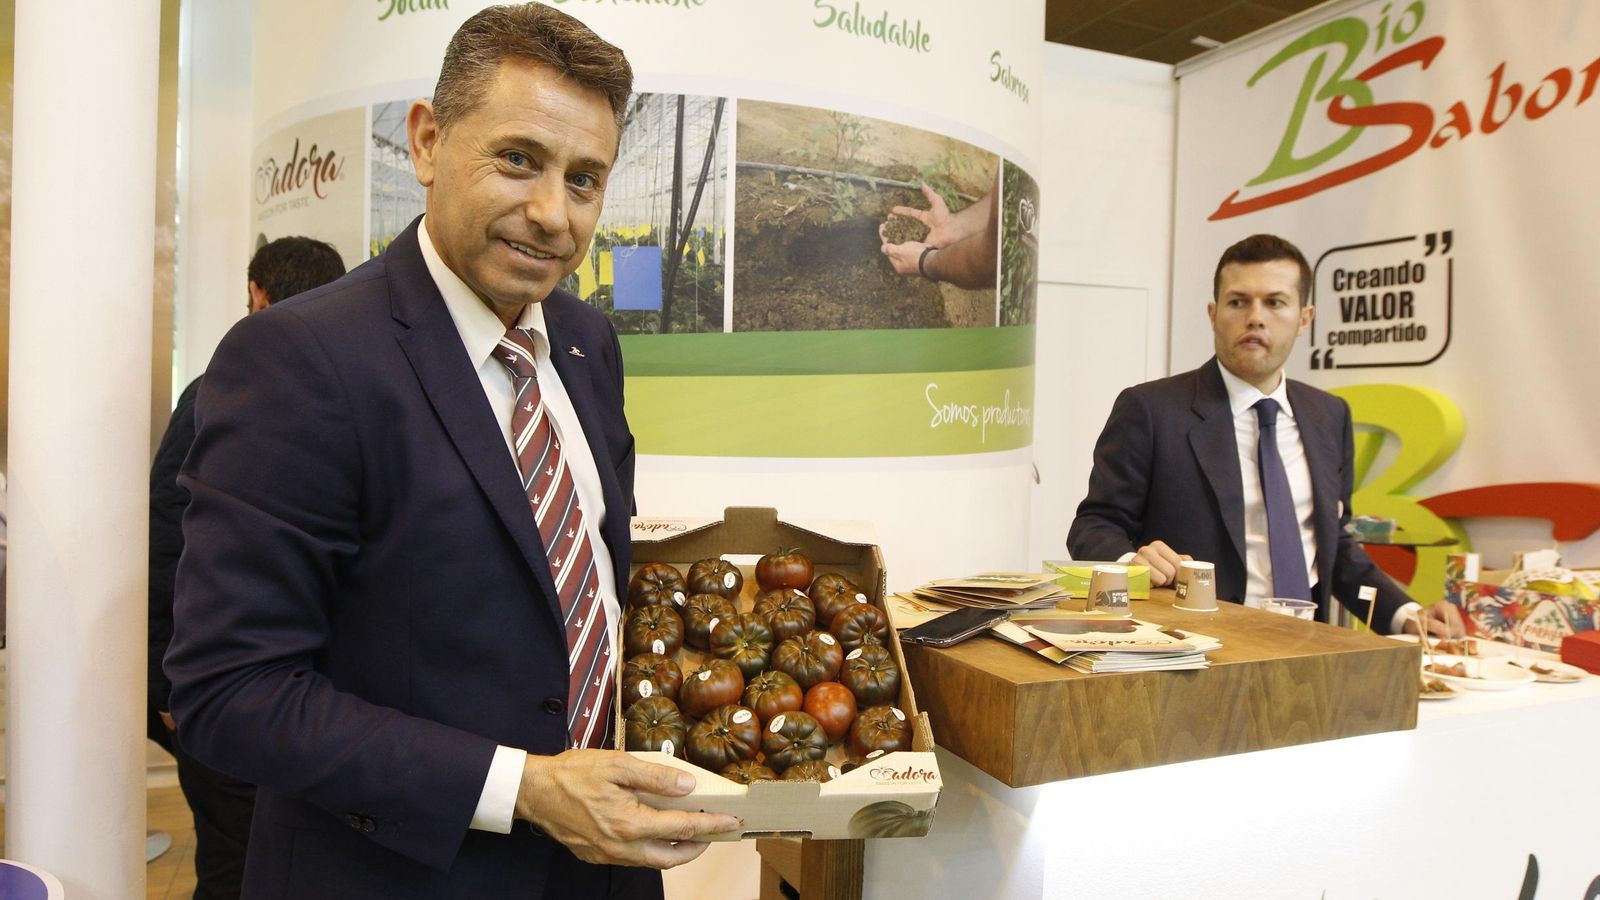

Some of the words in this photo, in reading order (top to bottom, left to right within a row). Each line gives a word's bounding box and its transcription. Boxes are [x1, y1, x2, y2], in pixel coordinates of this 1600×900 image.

[812, 0, 931, 53] Saludable
[1333, 260, 1426, 292] Creando
[1340, 291, 1415, 323] VALOR
[1327, 323, 1427, 347] compartido
[925, 383, 978, 428] Somos
